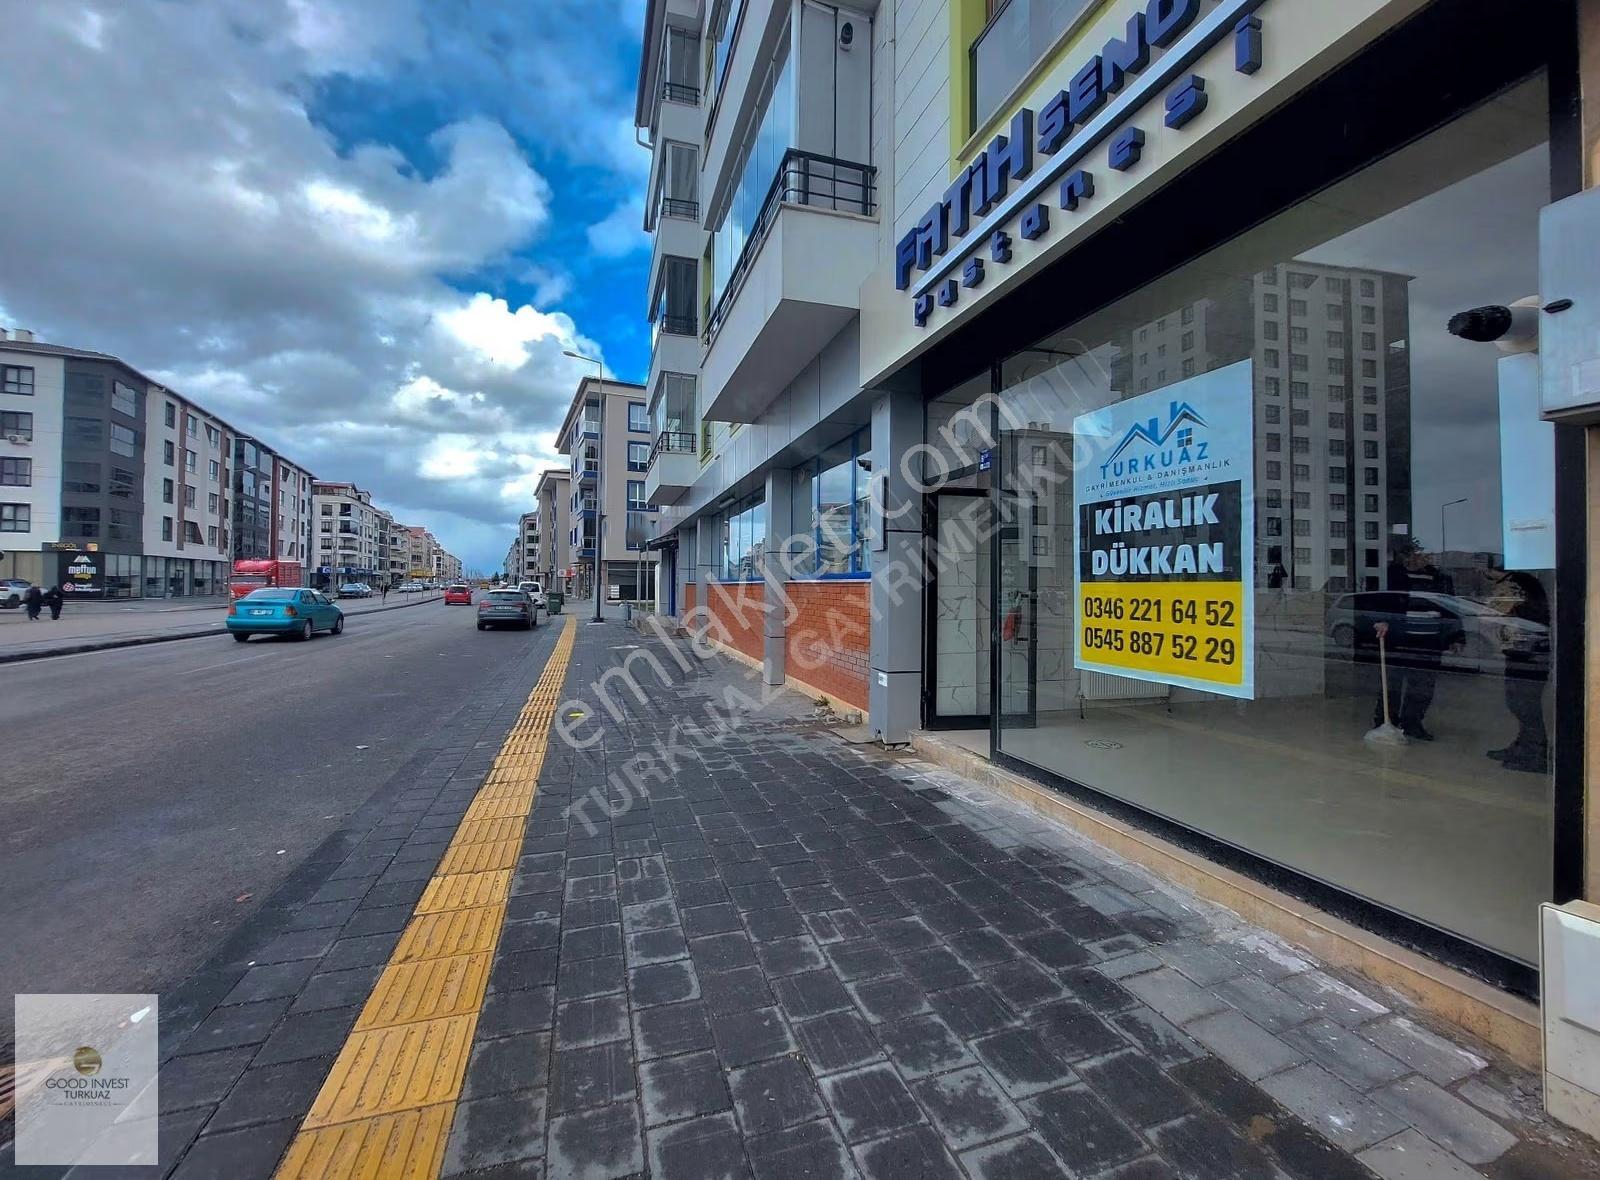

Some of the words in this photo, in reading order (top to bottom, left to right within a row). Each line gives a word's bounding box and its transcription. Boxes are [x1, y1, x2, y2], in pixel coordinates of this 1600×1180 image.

[1101, 442, 1209, 480] TURKUAZ
[1086, 476, 1143, 493] GAYRİMENKUL
[1094, 492, 1219, 535] KİRALIK
[1091, 541, 1224, 576] DÜKKAN
[1084, 597, 1124, 621] 0346
[1129, 598, 1162, 622] 221
[1171, 600, 1197, 625] 64
[1205, 600, 1235, 628] 52
[1084, 627, 1124, 652] 0545
[1130, 630, 1164, 656] 887
[1171, 634, 1197, 661] 52
[1205, 637, 1235, 666] 29
